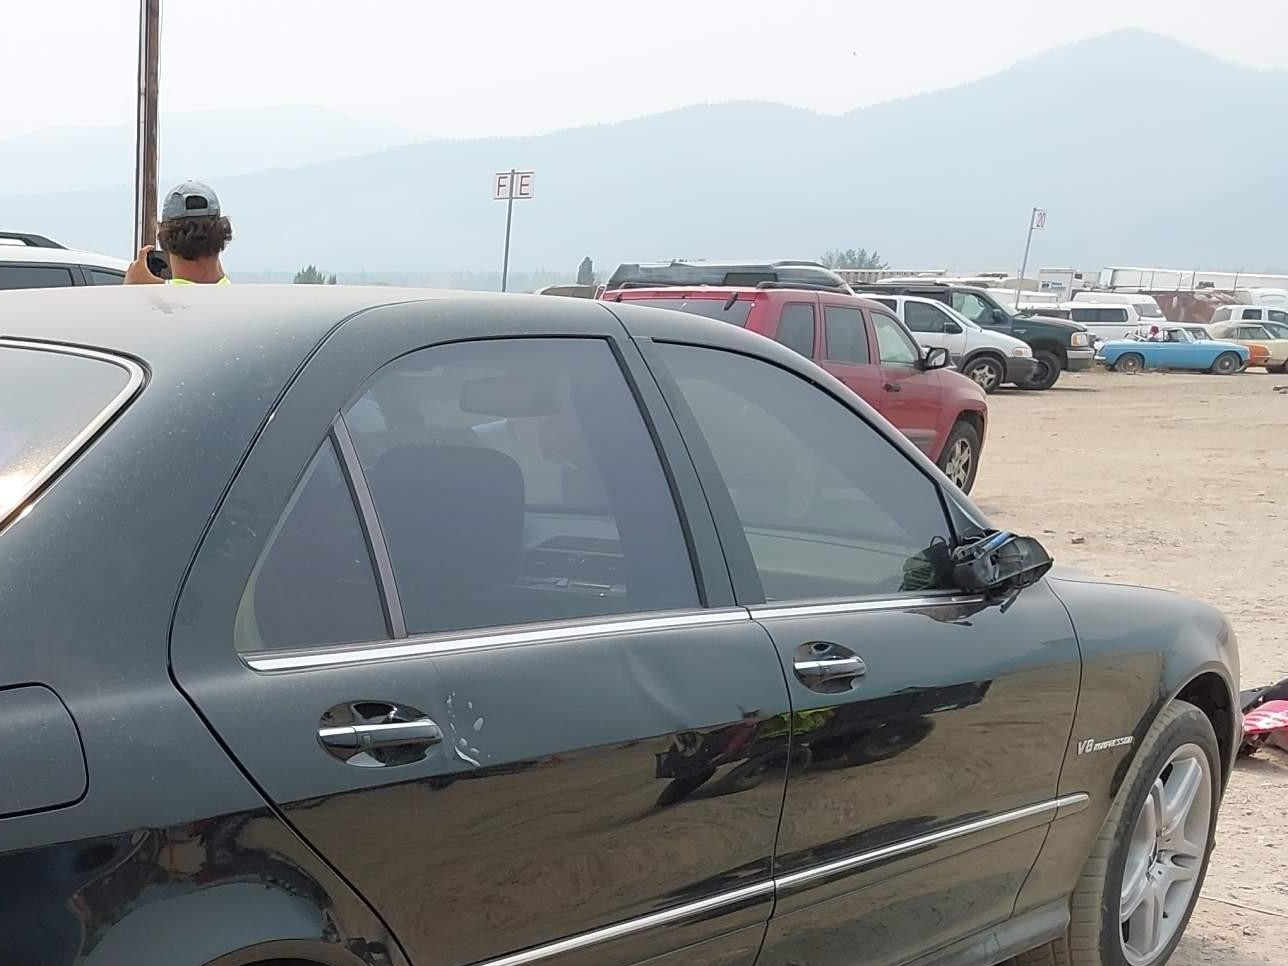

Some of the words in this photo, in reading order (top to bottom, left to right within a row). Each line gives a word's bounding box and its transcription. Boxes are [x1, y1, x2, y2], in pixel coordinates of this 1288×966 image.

[497, 176, 508, 196] F
[519, 175, 531, 196] E
[1078, 739, 1094, 755] V8
